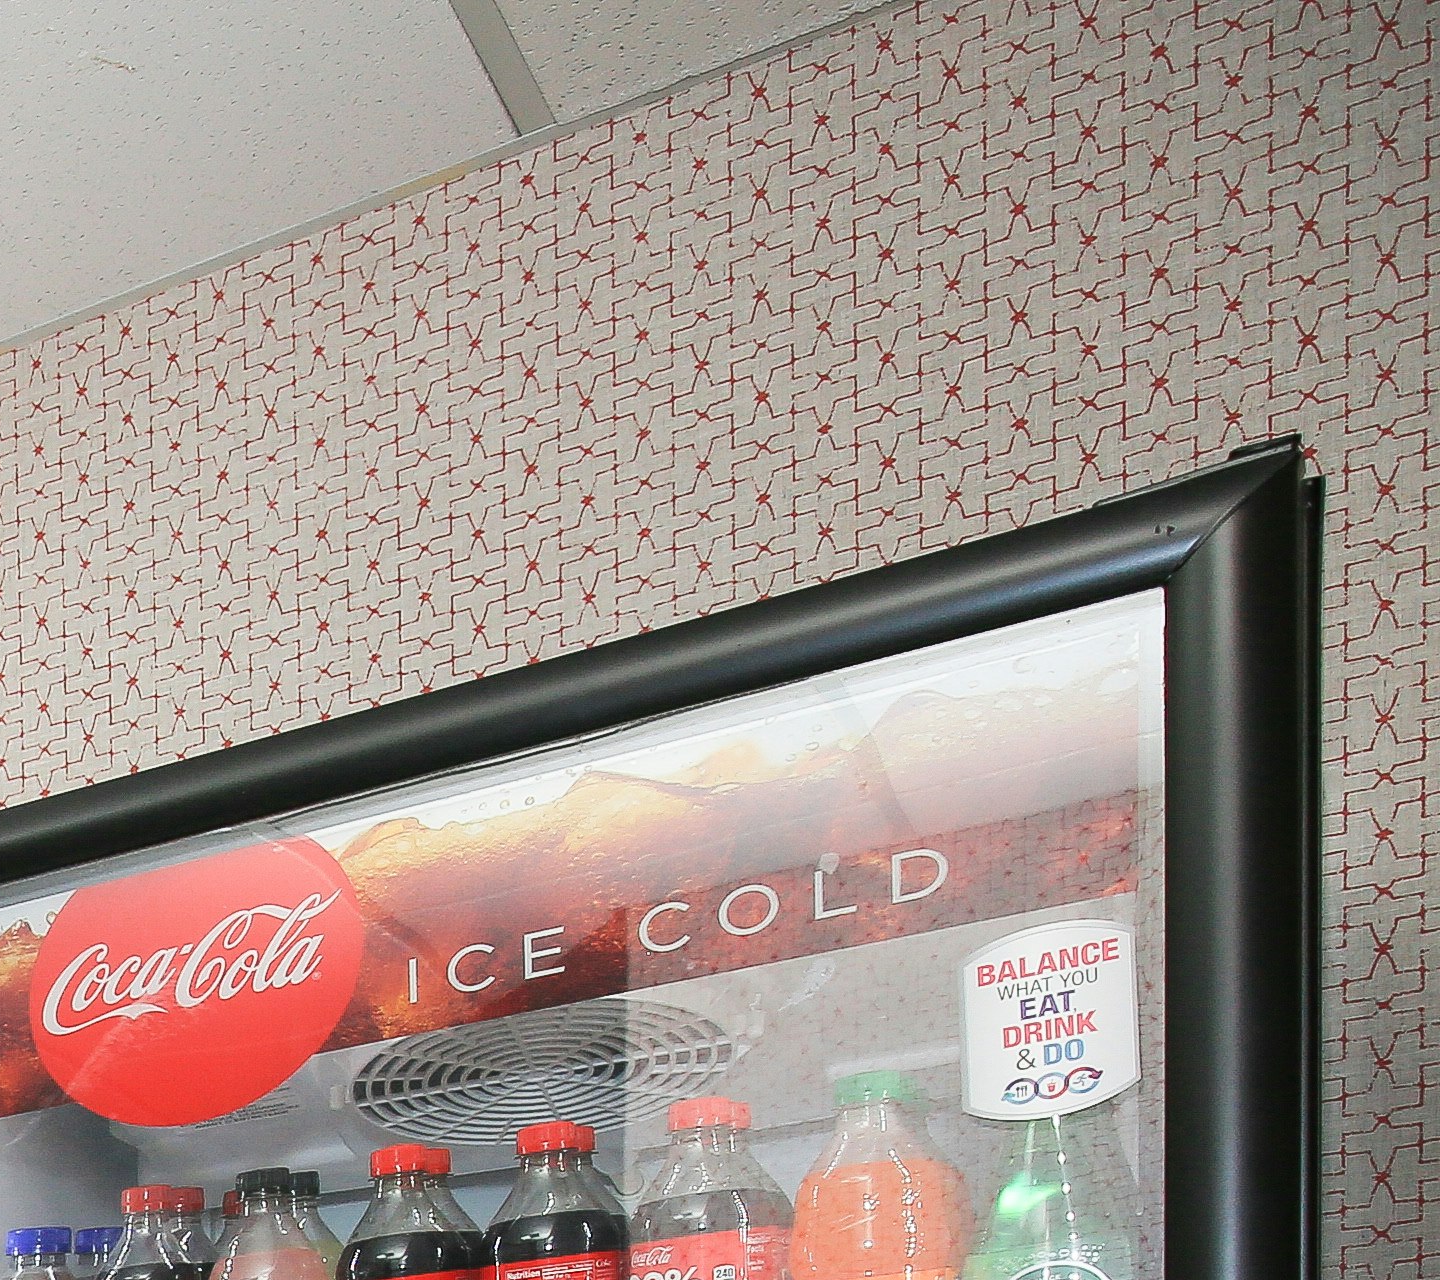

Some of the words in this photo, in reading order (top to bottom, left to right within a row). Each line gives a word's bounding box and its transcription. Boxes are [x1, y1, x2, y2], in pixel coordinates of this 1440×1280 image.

[408, 926, 566, 1004] ICE
[638, 848, 949, 953] COLD
[43, 888, 342, 1036] Coca-Cola
[977, 937, 1120, 987] BALANCE
[998, 976, 1054, 1000] WHAT
[1060, 967, 1098, 990] YOU
[1003, 1010, 1098, 1049] DRINK
[1016, 1048, 1036, 1071] &
[1043, 1039, 1084, 1064] DO
[507, 1269, 541, 1280] Nutrition
[715, 1268, 733, 1278] 240
